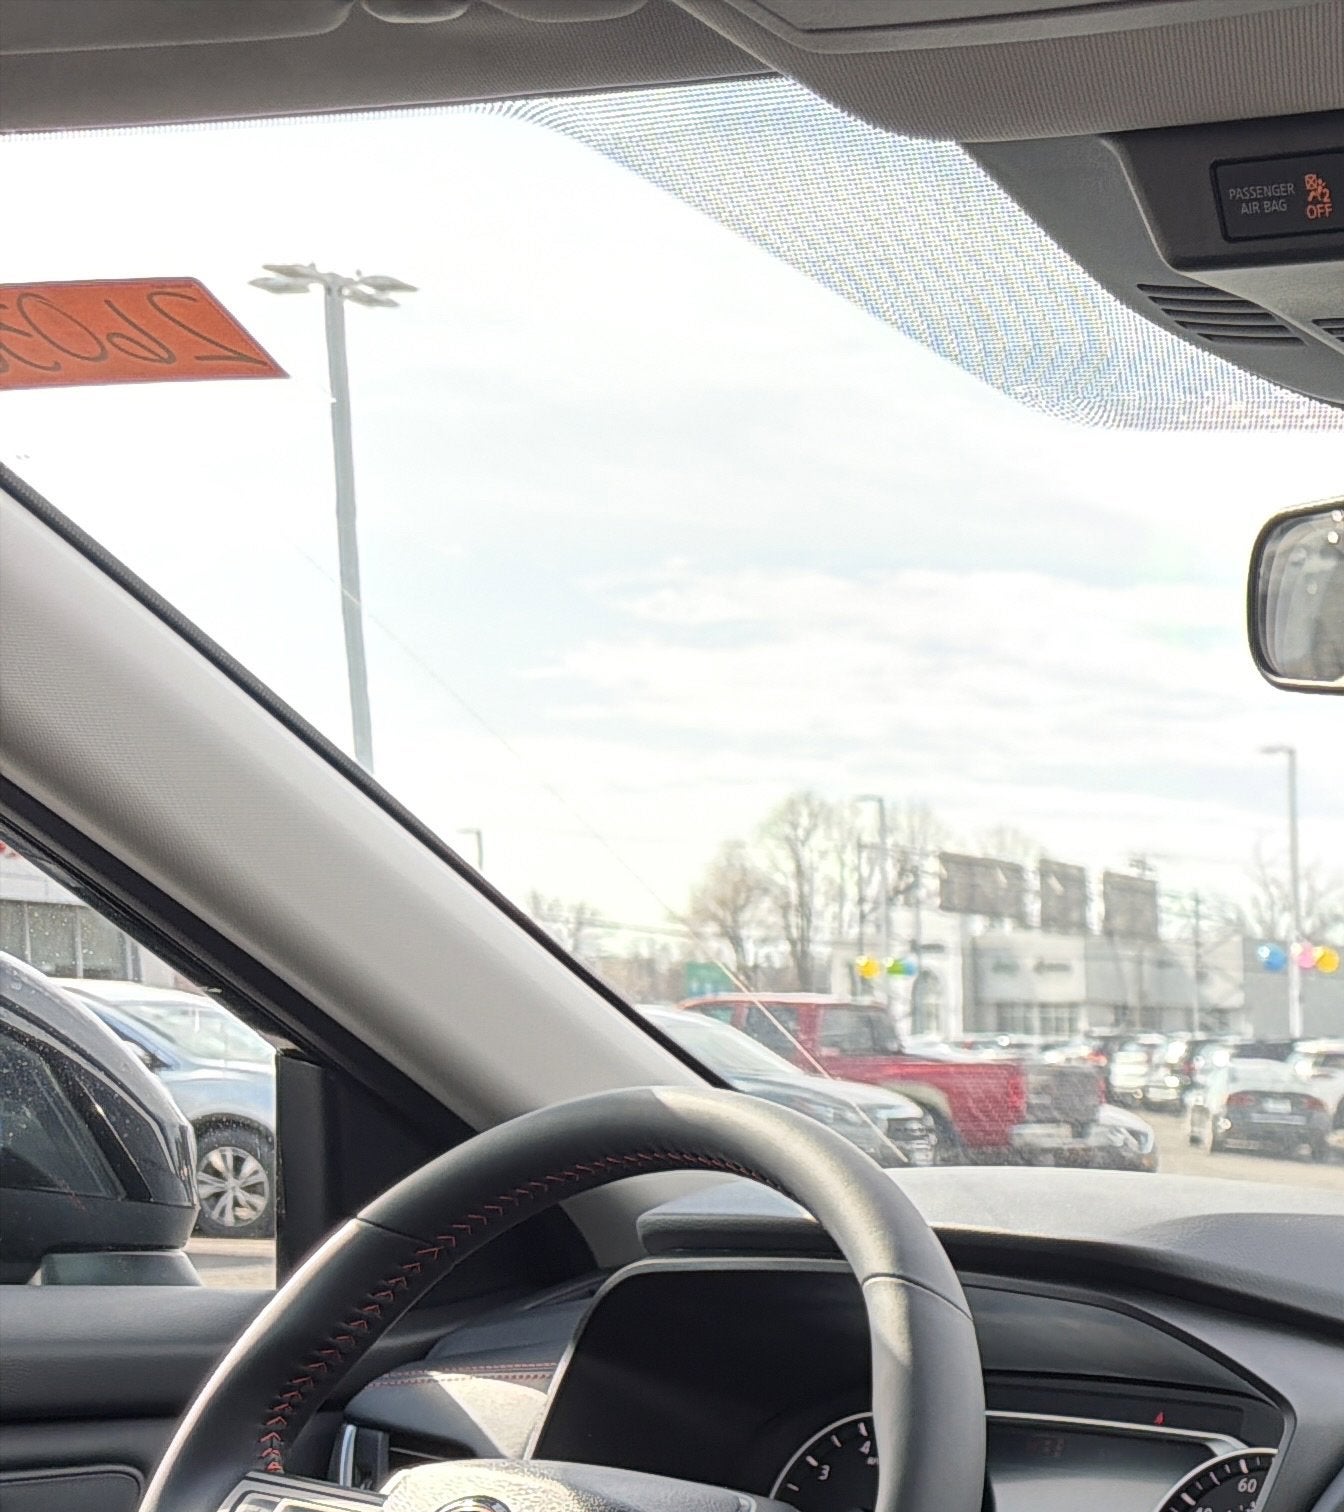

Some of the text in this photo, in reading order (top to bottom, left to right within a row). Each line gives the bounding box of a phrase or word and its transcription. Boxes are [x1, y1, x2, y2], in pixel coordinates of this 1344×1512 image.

[1228, 182, 1296, 200] PASSENGER
[1240, 199, 1288, 215] AIR BAG
[1306, 203, 1333, 219] OFF
[859, 1440, 872, 1455] 4
[818, 1464, 830, 1480] 3
[1237, 1477, 1258, 1494] 60
